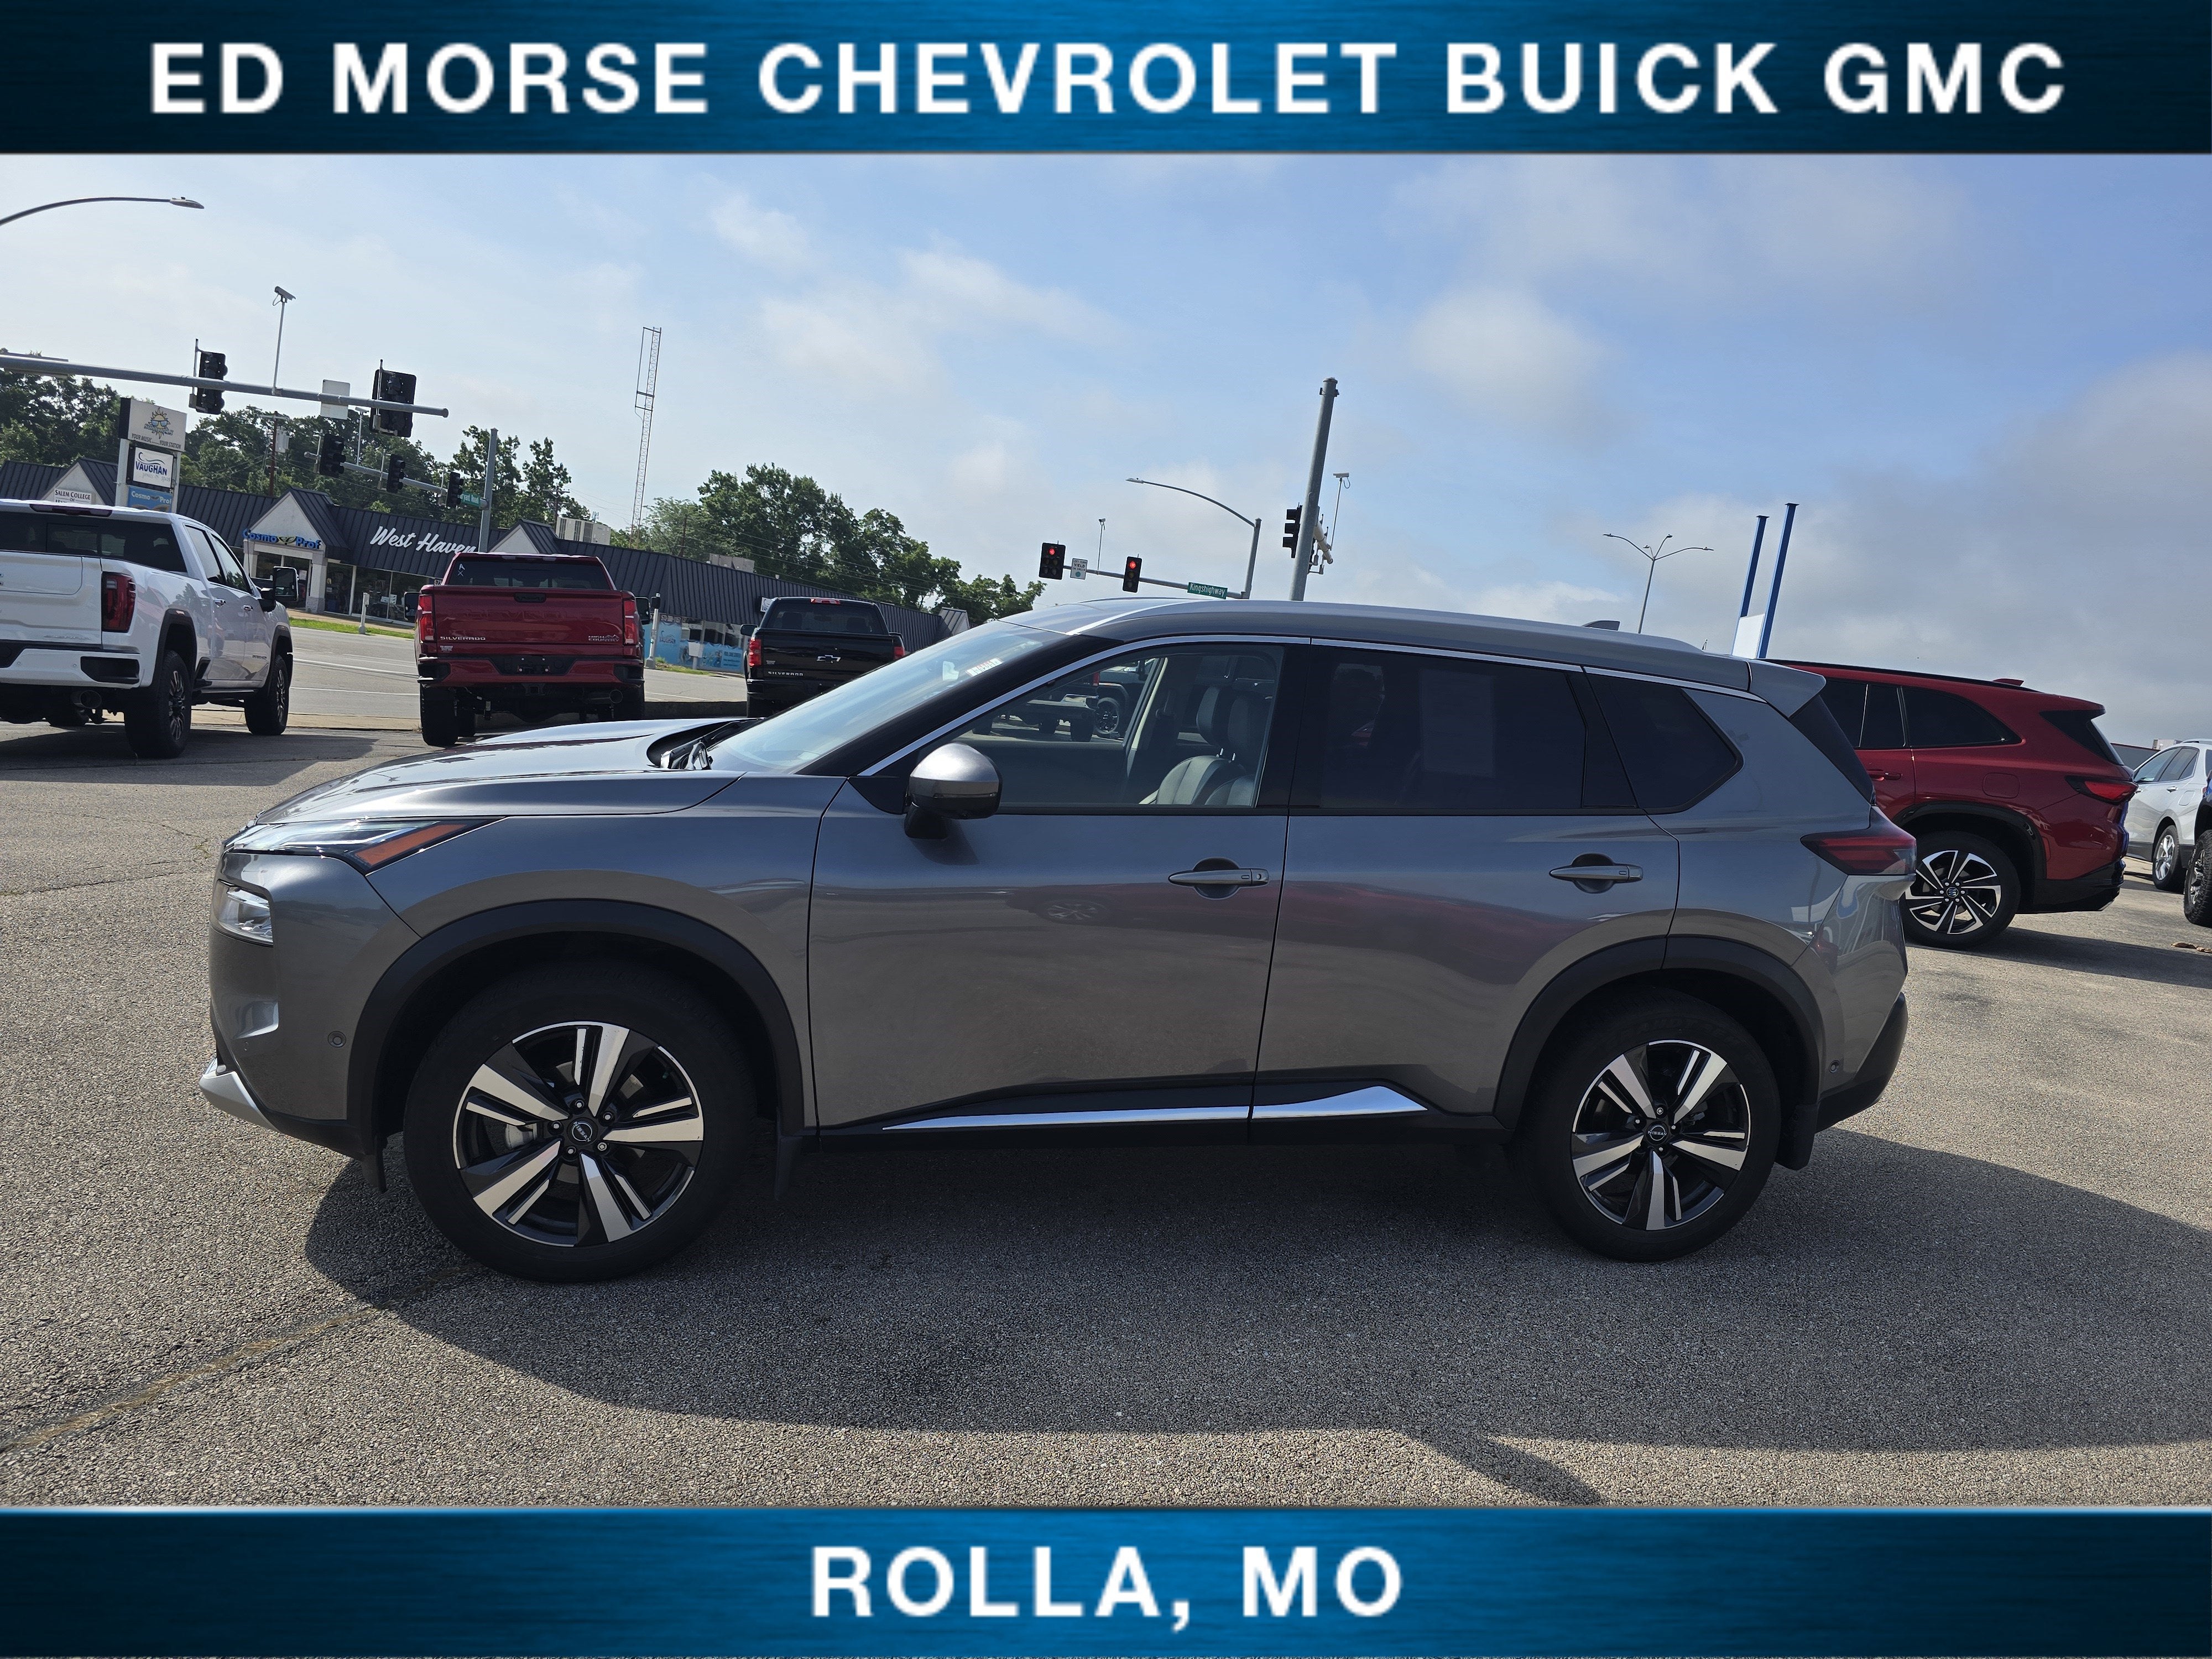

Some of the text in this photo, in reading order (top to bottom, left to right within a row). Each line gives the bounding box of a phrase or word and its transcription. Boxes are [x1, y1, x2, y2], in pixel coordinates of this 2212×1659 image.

[135, 461, 168, 476] VAUGHAN
[71, 492, 91, 500] COLLEGE
[131, 491, 151, 500] Cosmo
[242, 528, 321, 549] Cosmo Prof
[369, 525, 477, 554] West Haven
[1190, 583, 1225, 597] Kingshighway
[573, 1121, 591, 1142] NISSAN
